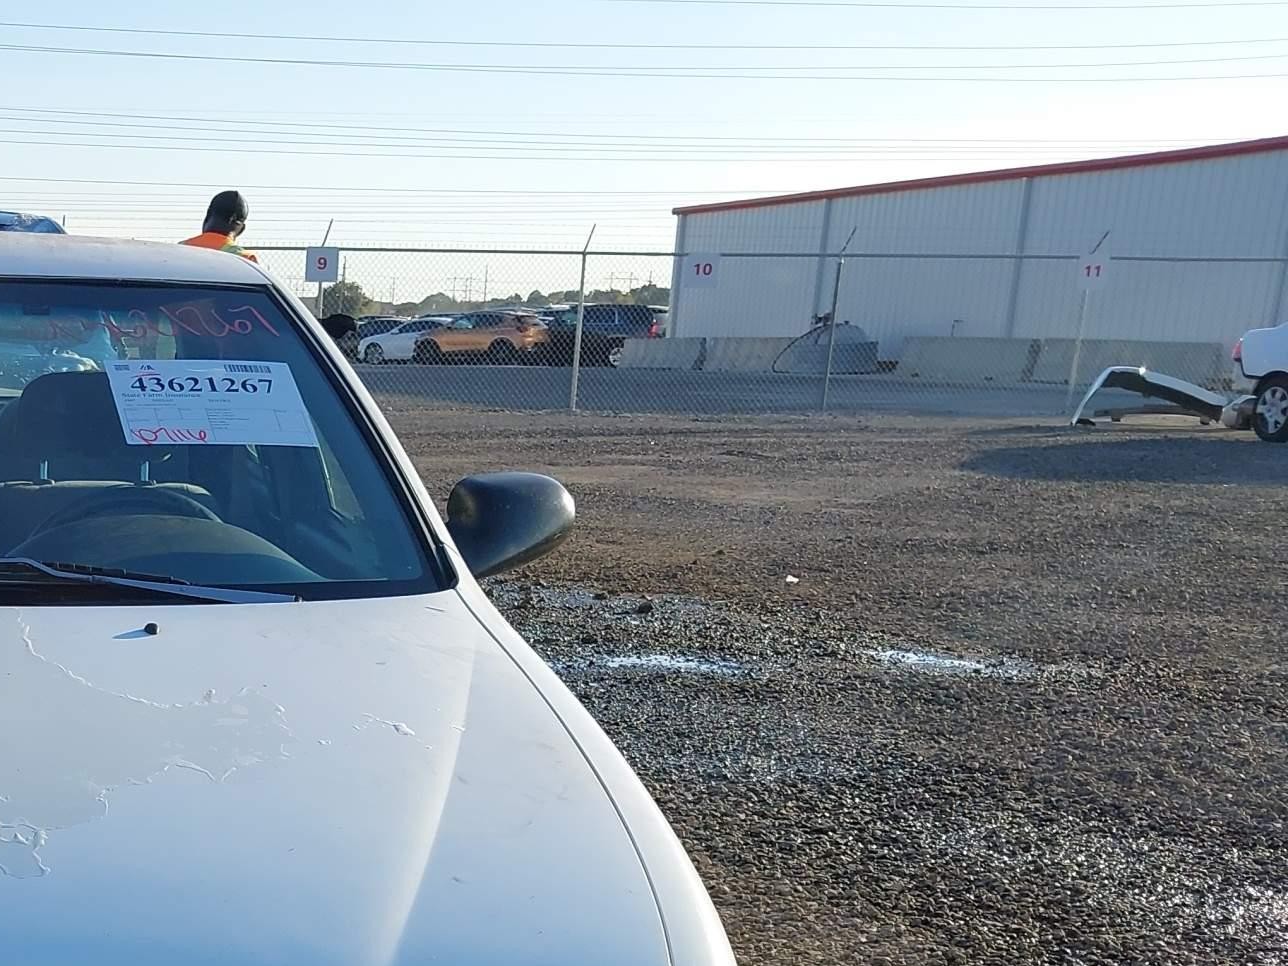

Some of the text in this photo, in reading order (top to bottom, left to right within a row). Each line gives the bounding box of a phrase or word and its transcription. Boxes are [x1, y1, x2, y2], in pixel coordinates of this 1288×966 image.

[317, 256, 328, 270] 9
[694, 263, 713, 276] 10
[1085, 264, 1102, 278] 11
[130, 376, 273, 394] 43621267
